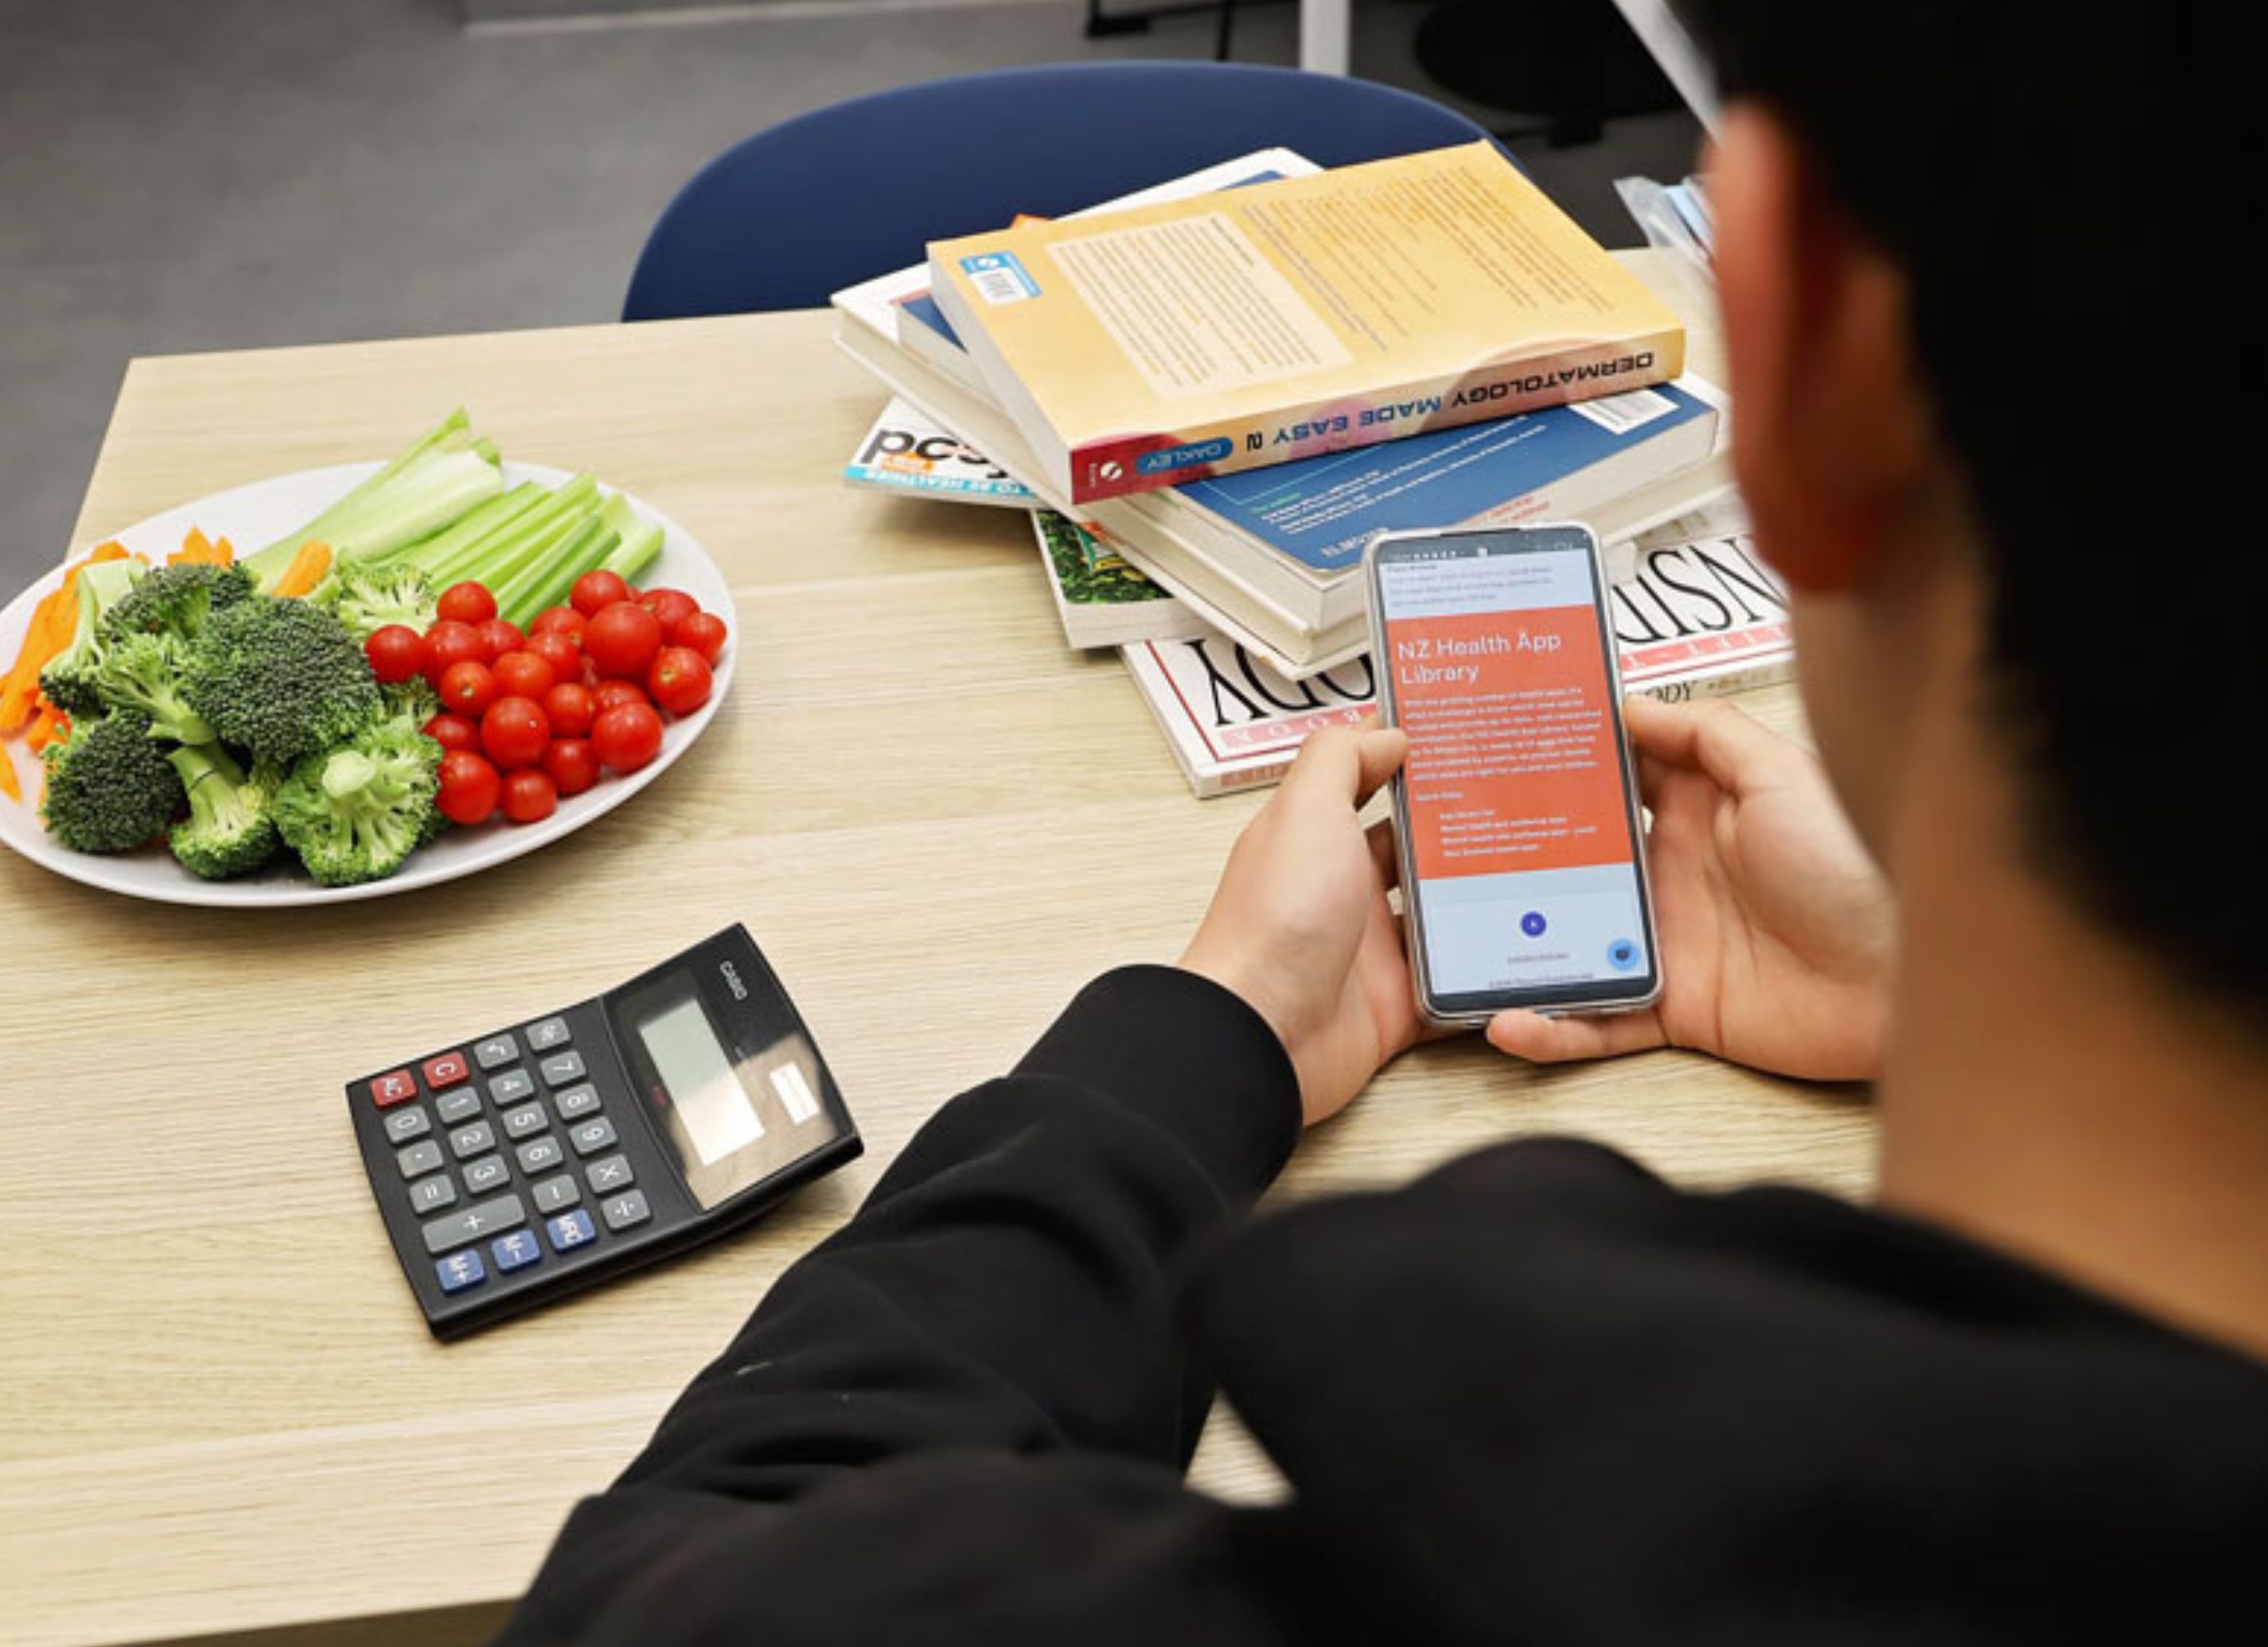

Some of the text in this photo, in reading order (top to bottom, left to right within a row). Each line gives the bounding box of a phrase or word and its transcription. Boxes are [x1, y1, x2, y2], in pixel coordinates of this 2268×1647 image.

[1246, 351, 1653, 451] DERMATOLOGY MADE EASY 2
[1148, 443, 1222, 469] OAKLEY
[1398, 633, 1561, 660] NZ Health App
[1401, 665, 1479, 685] Library
[719, 960, 747, 1000] CASIO
[435, 1062, 457, 1077] C
[552, 1059, 575, 1070] 7
[503, 1079, 522, 1091] 4
[567, 1092, 590, 1108] 8
[515, 1112, 537, 1127] 5
[462, 1130, 482, 1147] 2
[581, 1127, 605, 1141] 9
[529, 1146, 551, 1162] 6
[473, 1165, 497, 1182] 3
